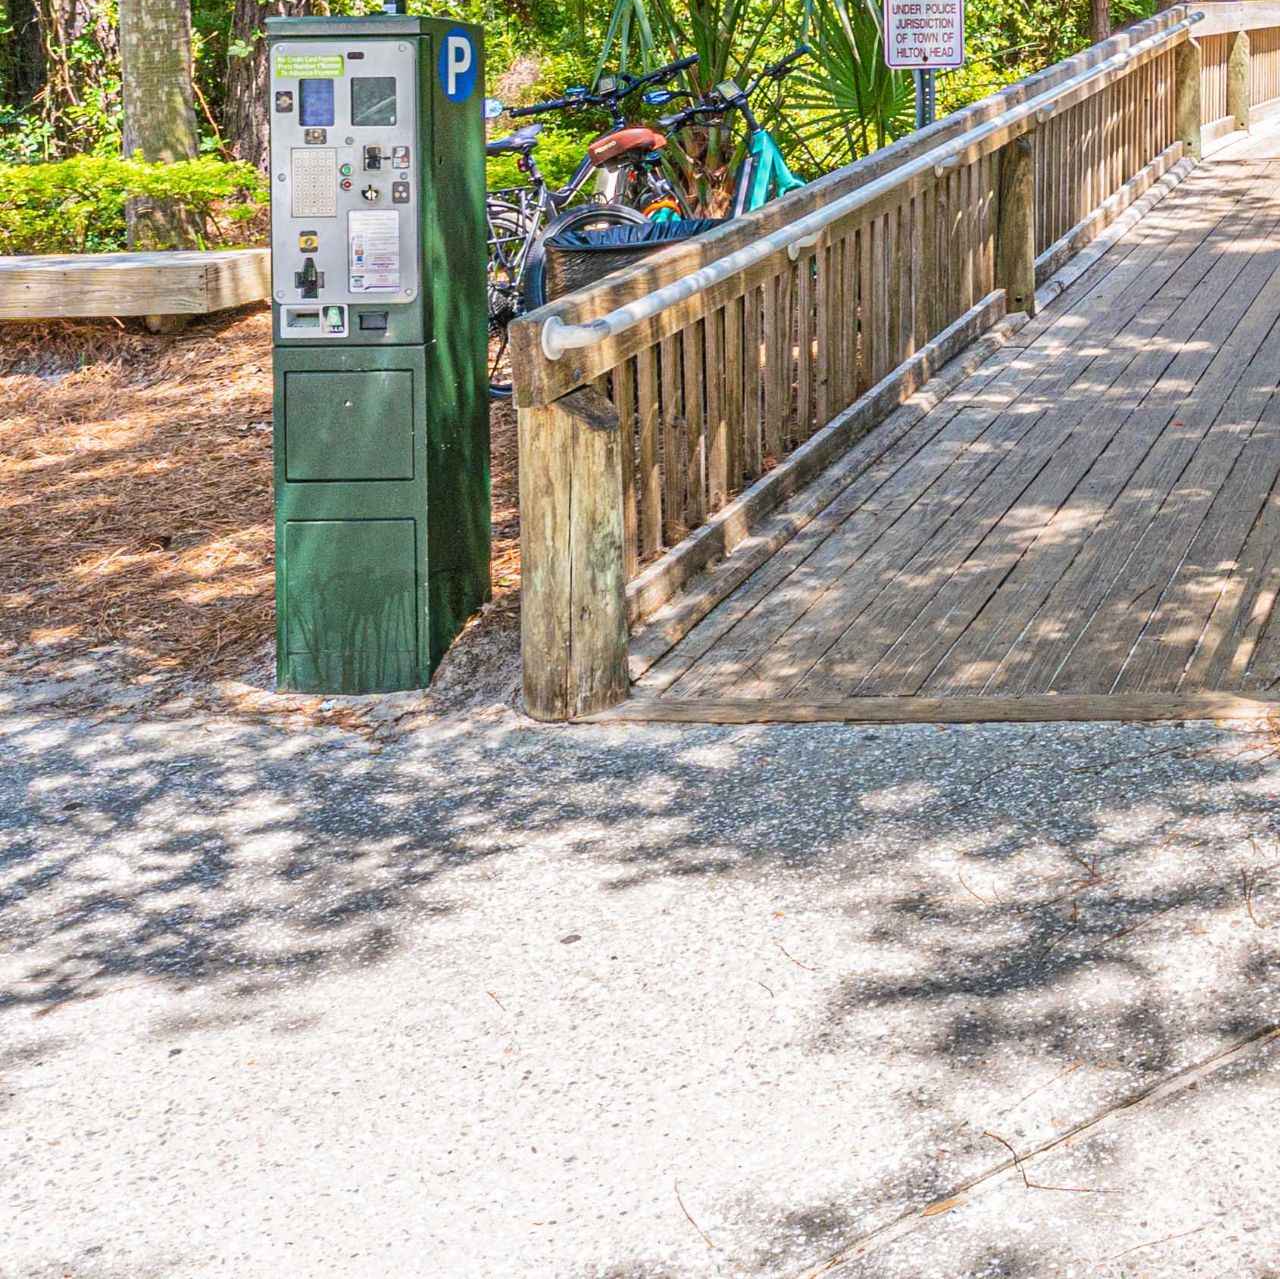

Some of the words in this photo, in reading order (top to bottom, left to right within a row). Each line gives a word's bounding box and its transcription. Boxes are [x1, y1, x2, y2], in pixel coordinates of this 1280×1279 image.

[892, 4, 921, 15] UNDER
[925, 4, 956, 14] POLICE
[896, 18, 954, 29] JURISDICTION
[896, 33, 908, 44] OF
[912, 33, 938, 43] TOWN
[942, 33, 954, 43] OF
[896, 48, 926, 58] HILTON
[930, 47, 954, 57] HEAD
[447, 36, 471, 95] P
